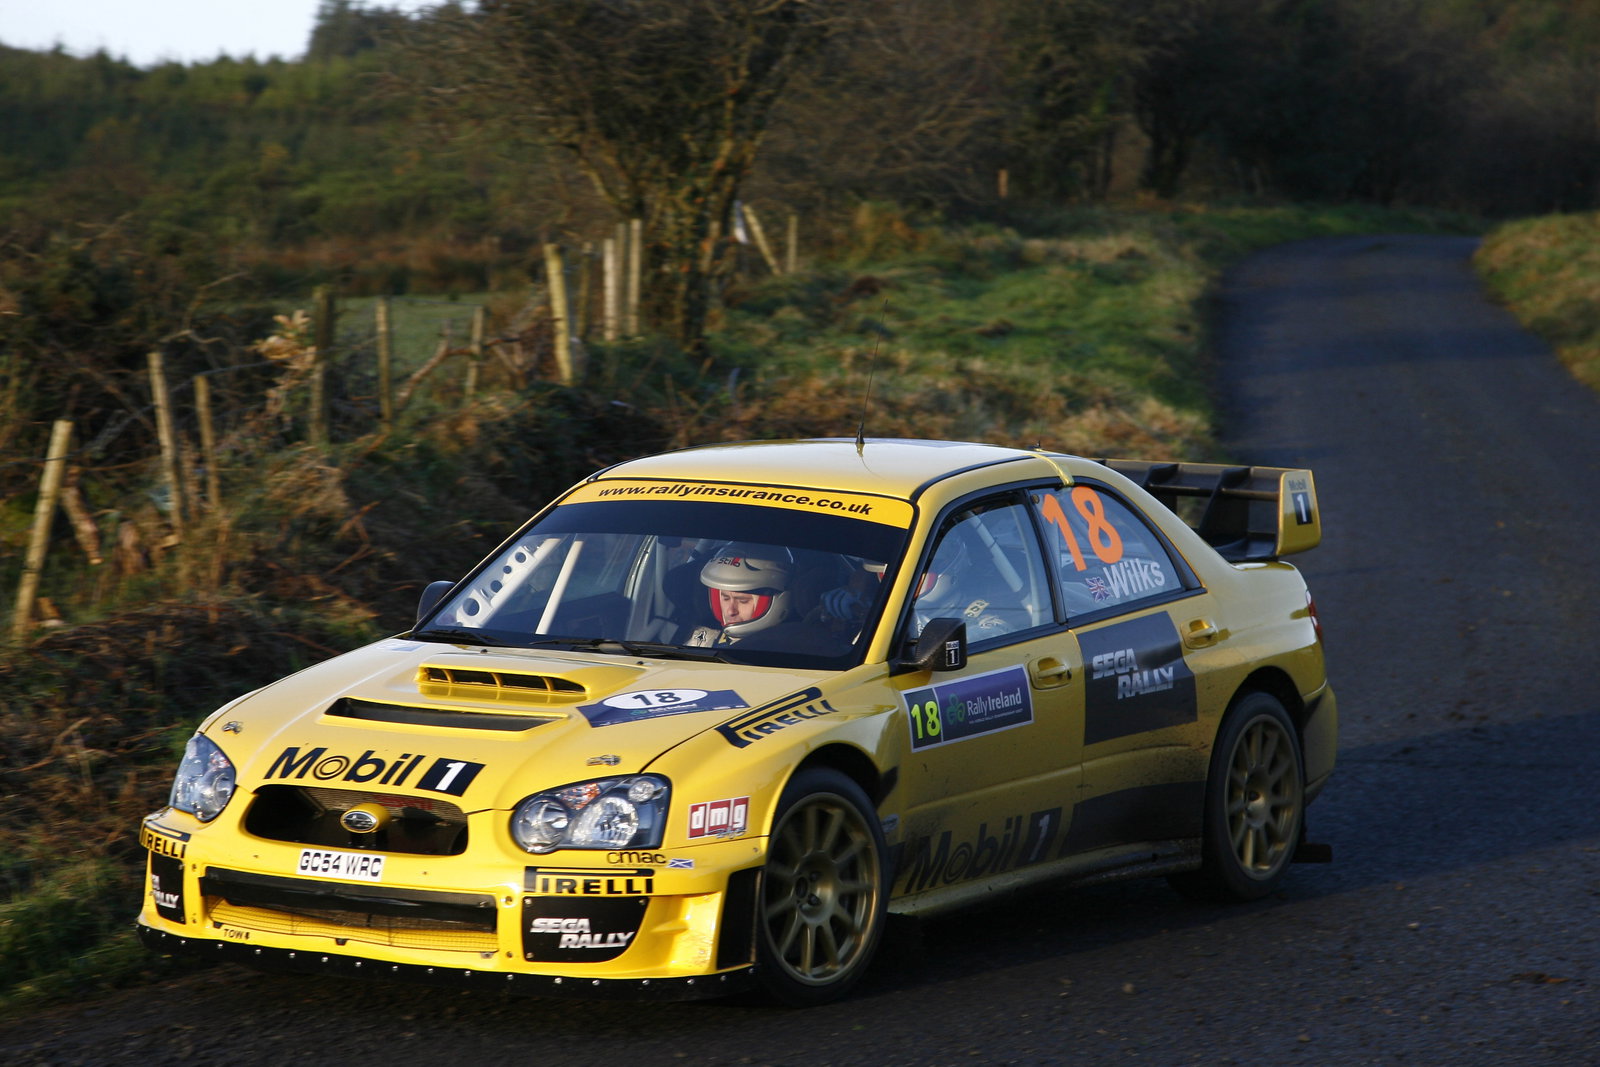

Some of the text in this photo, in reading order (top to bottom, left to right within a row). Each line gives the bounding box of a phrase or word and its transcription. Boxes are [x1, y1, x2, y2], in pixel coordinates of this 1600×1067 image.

[598, 484, 873, 516] www.rallyinsurance.co.uk
[1041, 486, 1123, 572] 18
[1103, 558, 1165, 599] Wilks
[1092, 648, 1139, 679] SEGA
[1117, 666, 1175, 699] RALLY
[633, 692, 682, 706] 18
[714, 686, 839, 749] PIRELLI
[911, 701, 941, 739] 18
[264, 747, 425, 786] Mobil
[691, 804, 747, 829] dmg
[300, 851, 381, 877] GC54 WRC
[606, 851, 667, 865] cmac
[904, 815, 1023, 894] Mobil
[525, 866, 655, 894] PIRELLI
[224, 928, 243, 939] TOW
[530, 918, 590, 933] SEGA
[559, 931, 634, 949] RALLY
